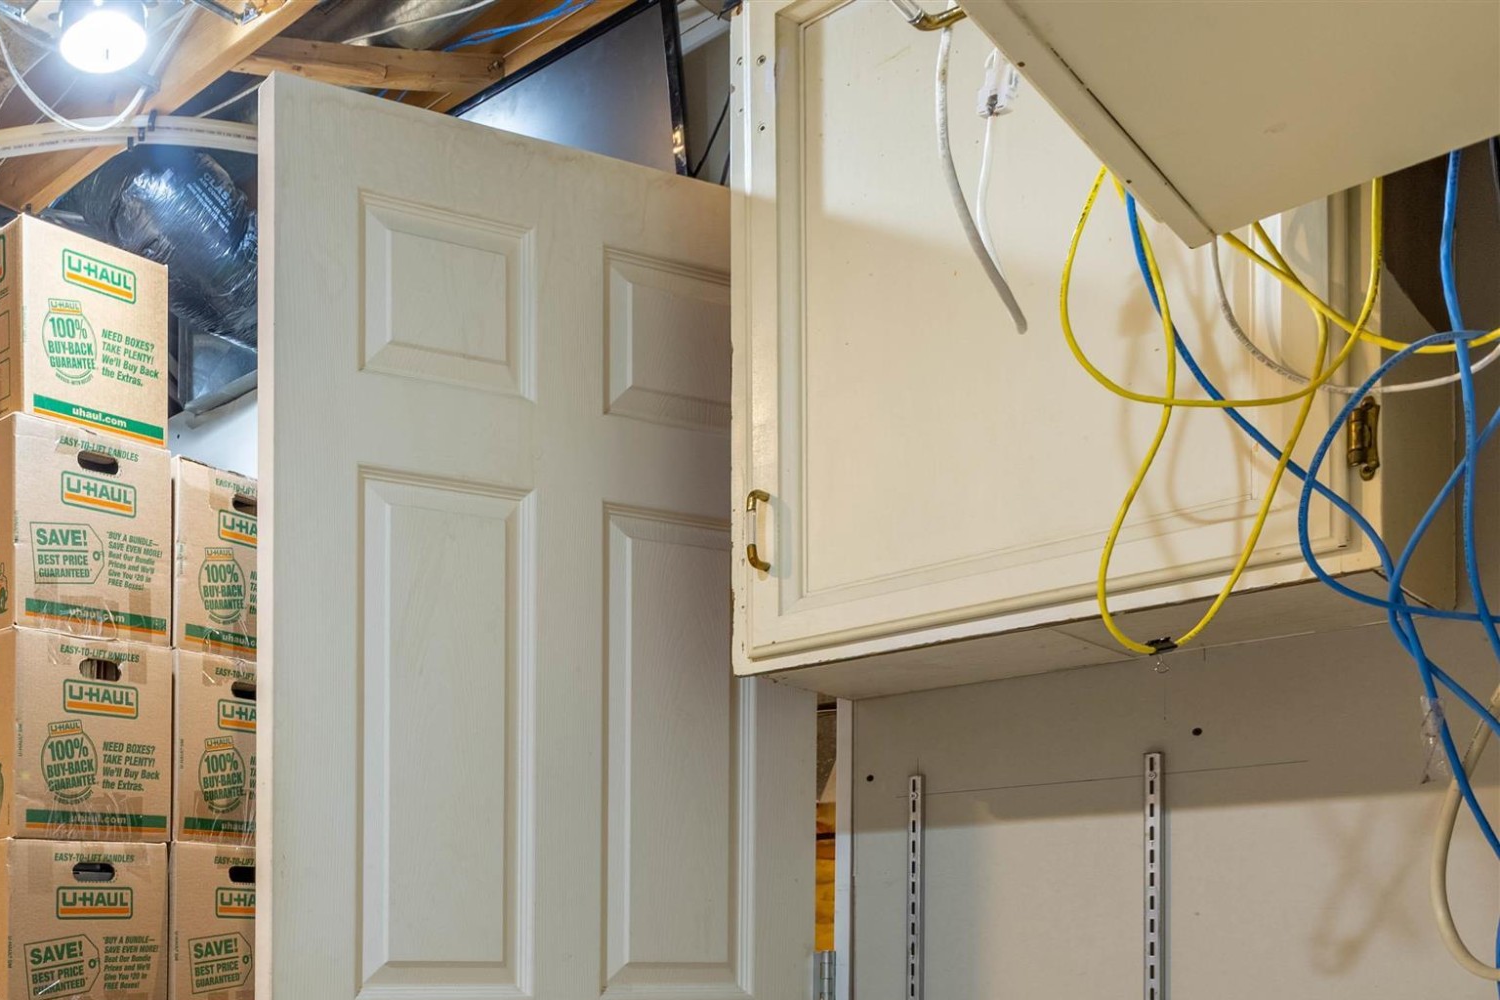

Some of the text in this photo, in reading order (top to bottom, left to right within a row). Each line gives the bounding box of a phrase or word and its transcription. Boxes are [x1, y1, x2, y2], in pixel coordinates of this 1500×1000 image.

[68, 255, 132, 290] U-HAUL
[51, 301, 79, 310] U-HAUL
[50, 317, 87, 339] 100%
[48, 341, 93, 355] BUY-BACK
[102, 329, 154, 351] NEED BOXES?
[102, 342, 154, 364] TAKE PLENTY!
[51, 356, 96, 370] GUARANTEE
[102, 355, 159, 379] We'll Buy Back
[102, 367, 115, 379] the
[117, 373, 143, 387] Extras.
[72, 407, 127, 428] uhaul.com
[60, 436, 106, 453] EASY-TO-LIFT
[66, 478, 132, 505] U-HAUL
[36, 528, 87, 546] SAVE!
[38, 554, 88, 565] BEST PRICE
[205, 564, 238, 583] 100%
[203, 585, 243, 597] BUY-BACK
[204, 600, 245, 611] GUARANTEE
[60, 644, 105, 659] EASY-TO-LIFT
[69, 685, 134, 706] U-HAUL
[48, 737, 89, 762] 100%
[103, 741, 155, 755] NEED BOXES?
[47, 759, 94, 778] BUY-BACK
[103, 754, 155, 767] TAKE PLENTY!
[102, 767, 159, 780] We'll Buy Back
[49, 774, 96, 792] GUARANTEE
[102, 780, 144, 792] the Extras.
[55, 853, 134, 862] EASY-TO-LIFT HANDLES
[62, 892, 128, 906] U-HAUL
[30, 941, 83, 965] SAVE!
[105, 945, 121, 954] SAVE
[122, 945, 138, 953] EVEN
[193, 938, 238, 959] SAVE!
[32, 965, 84, 984] BEST PRICE
[124, 964, 135, 972] and
[195, 961, 239, 977] BEST PRICE
[104, 981, 118, 990] FREE
